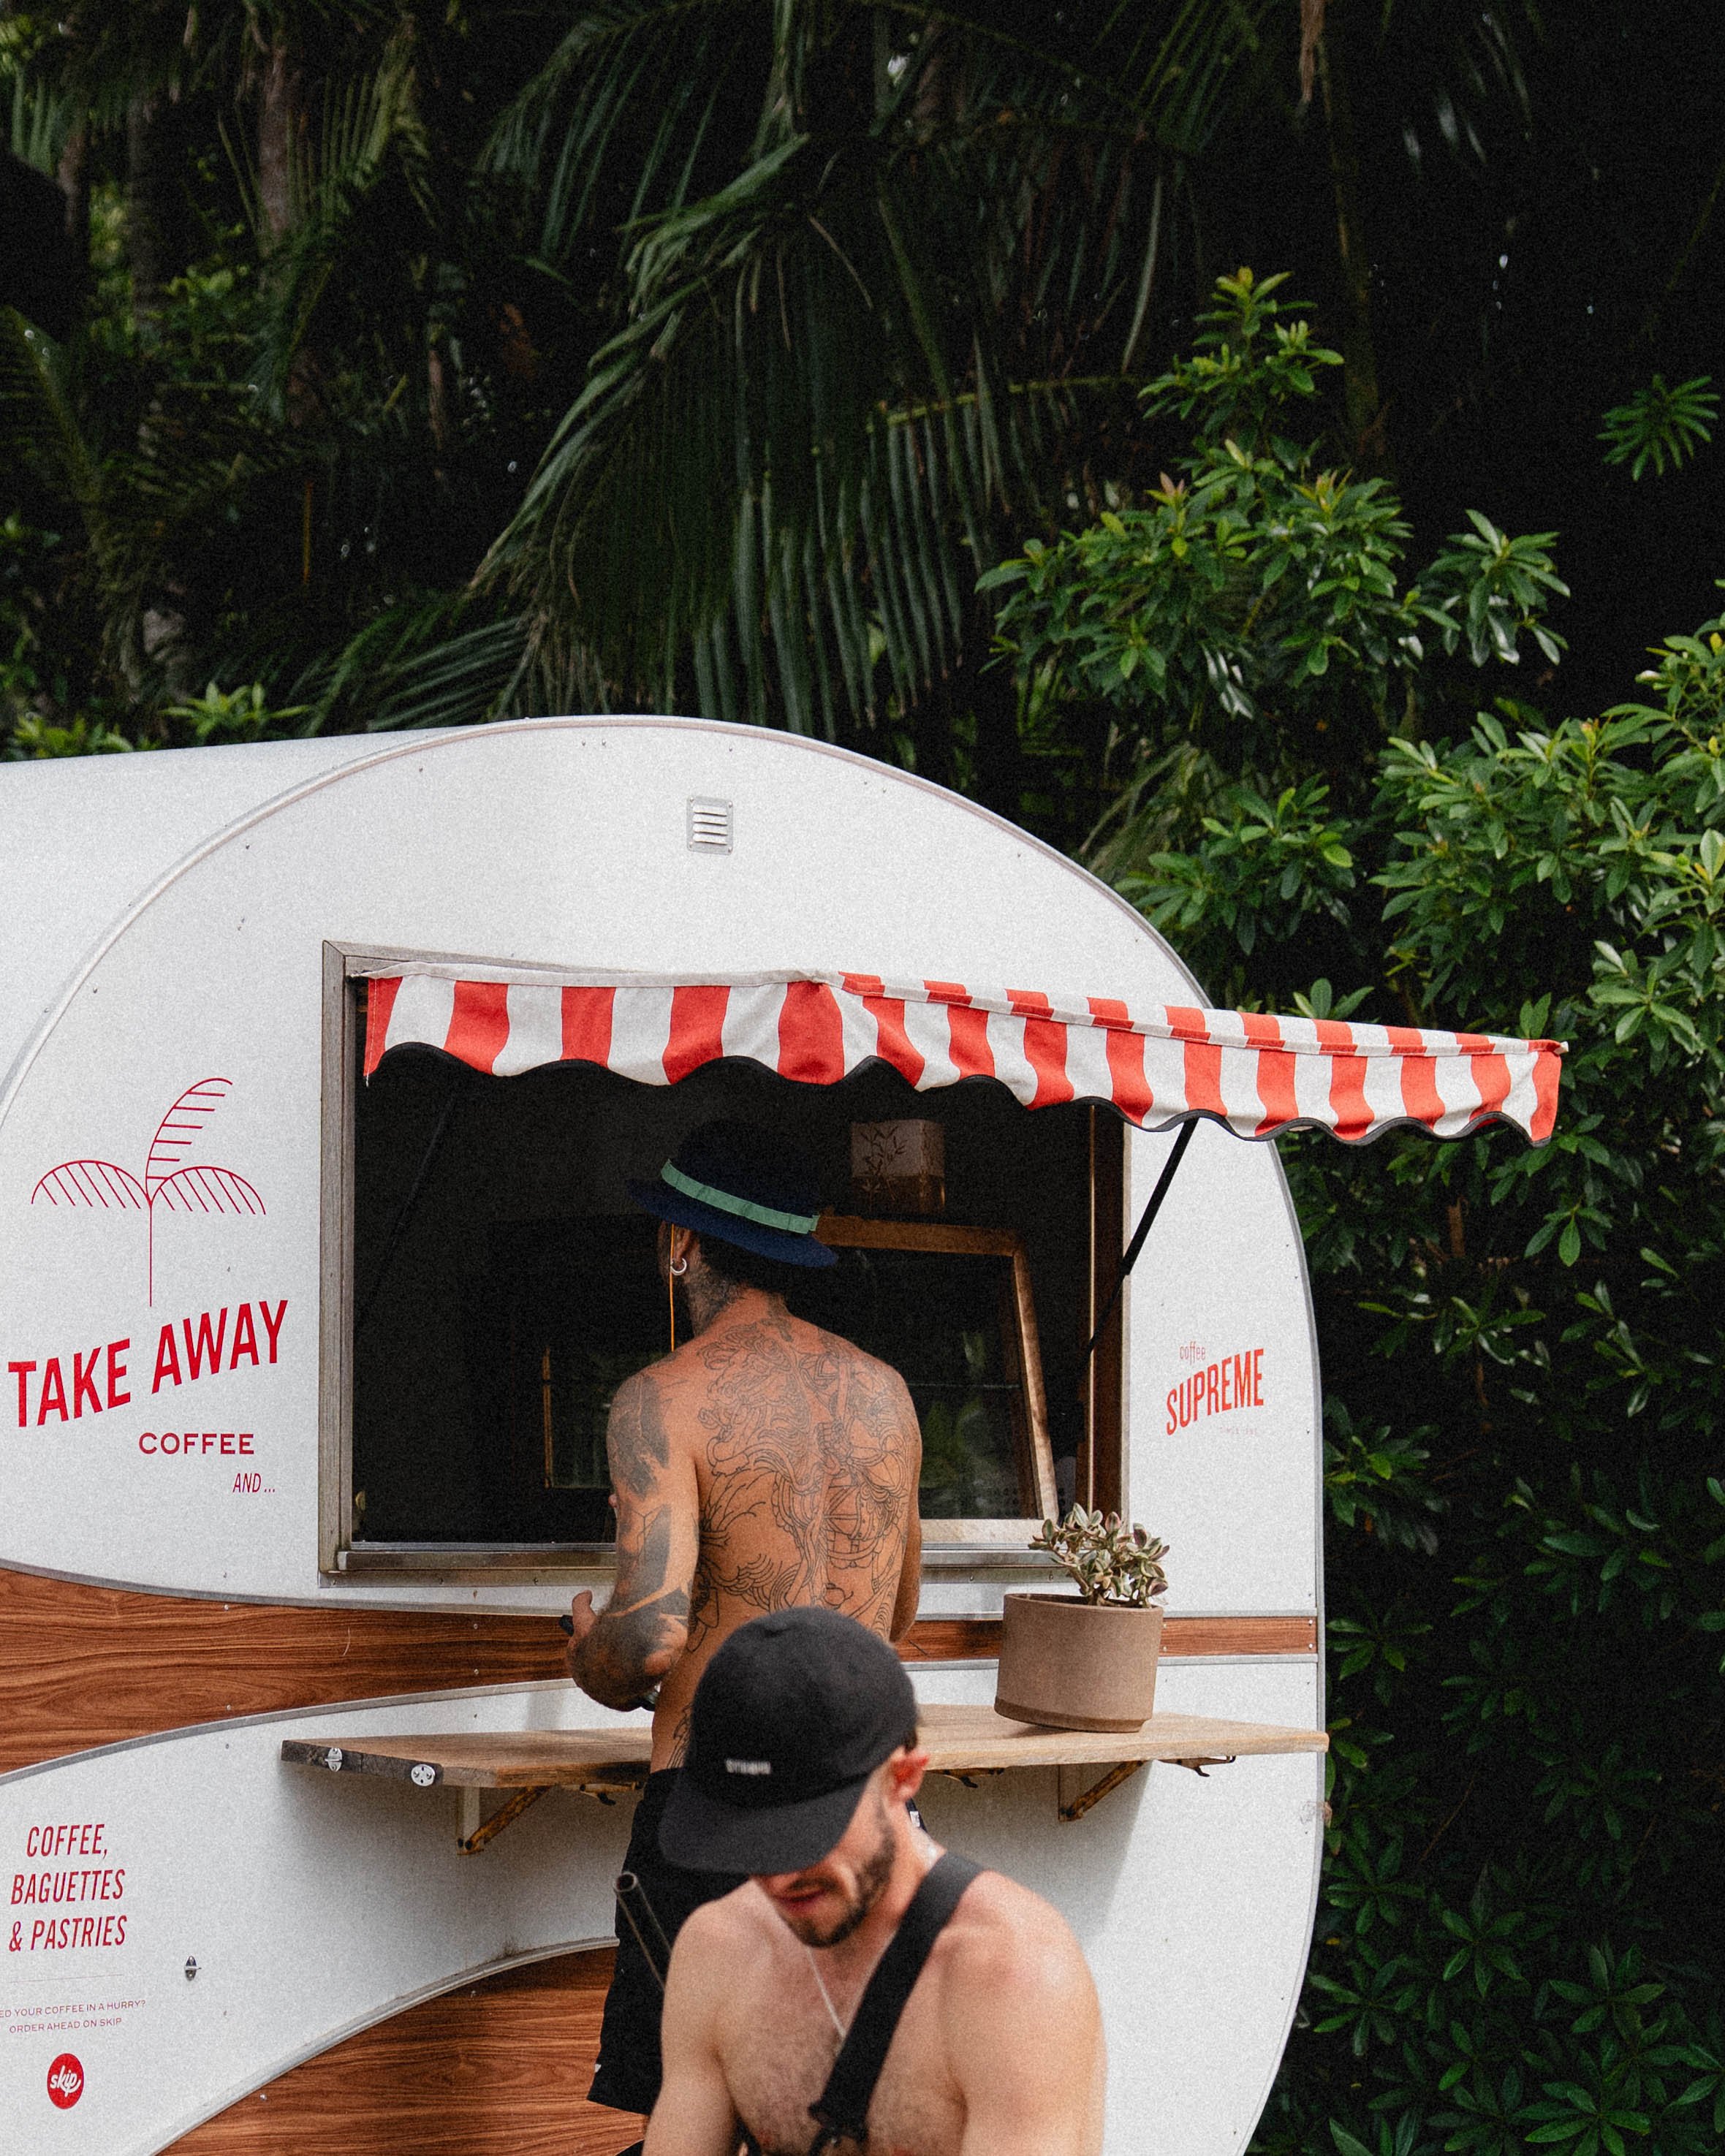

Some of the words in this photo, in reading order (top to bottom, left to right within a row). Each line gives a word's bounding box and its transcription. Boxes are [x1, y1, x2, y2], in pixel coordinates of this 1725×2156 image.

[7, 1337, 131, 1427] TAKE
[151, 1299, 288, 1394] AWAY
[1179, 1341, 1206, 1365] coffee
[1166, 1348, 1265, 1435] SUPREME
[139, 1432, 254, 1454] COFFEE
[232, 1473, 276, 1493] AND...
[26, 1823, 108, 1859] COFFEE,
[10, 1869, 126, 1905] BAGUETTES
[9, 1921, 23, 1952] &
[30, 1915, 127, 1951] PASTRIES
[15, 2007, 42, 2016] YOUR
[45, 2005, 84, 2015] COFFEE
[86, 2003, 96, 2011] IN
[99, 2003, 105, 2011] A
[107, 2000, 145, 2010] HURRY?
[9, 2023, 45, 2033] ORDER
[47, 2021, 80, 2030] AHEAD
[83, 2019, 97, 2028] ON
[100, 2017, 122, 2027] SKIP
[50, 2065, 82, 2098] skip
